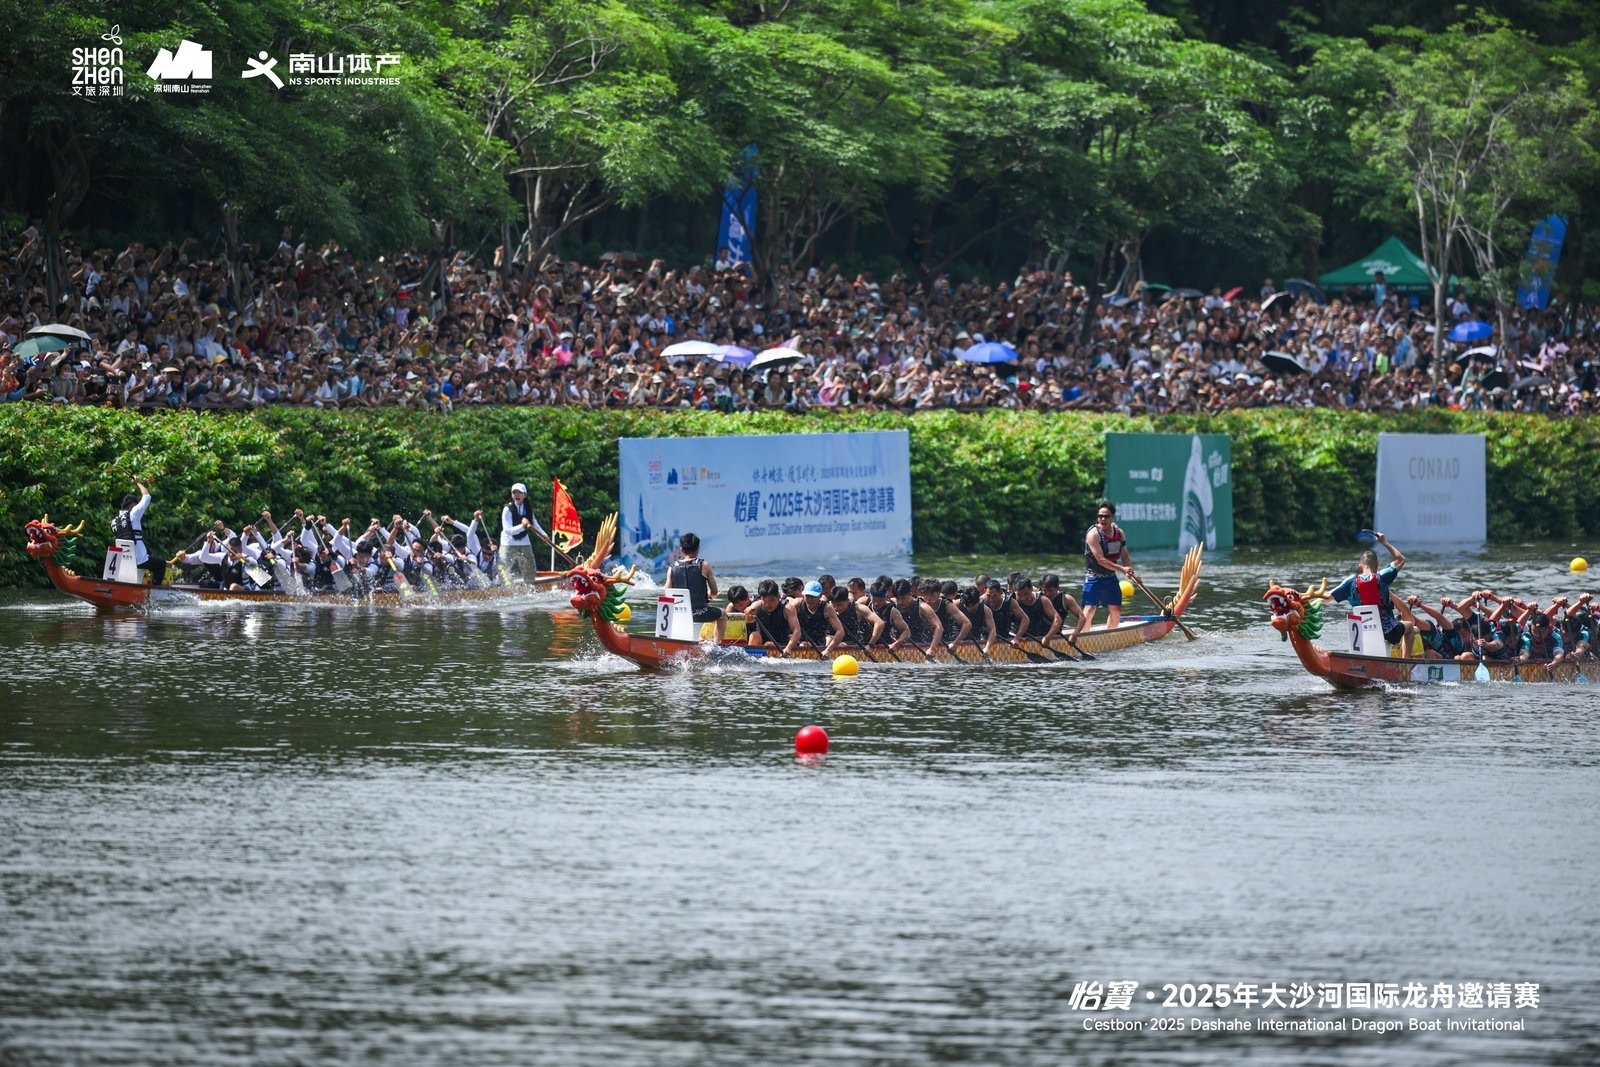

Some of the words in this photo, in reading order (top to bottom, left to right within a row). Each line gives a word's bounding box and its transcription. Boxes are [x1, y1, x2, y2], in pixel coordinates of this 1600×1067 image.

[1408, 456, 1461, 480] CONRAD
[108, 553, 118, 575] 4
[660, 604, 670, 632] 3
[1352, 622, 1361, 652] 2
